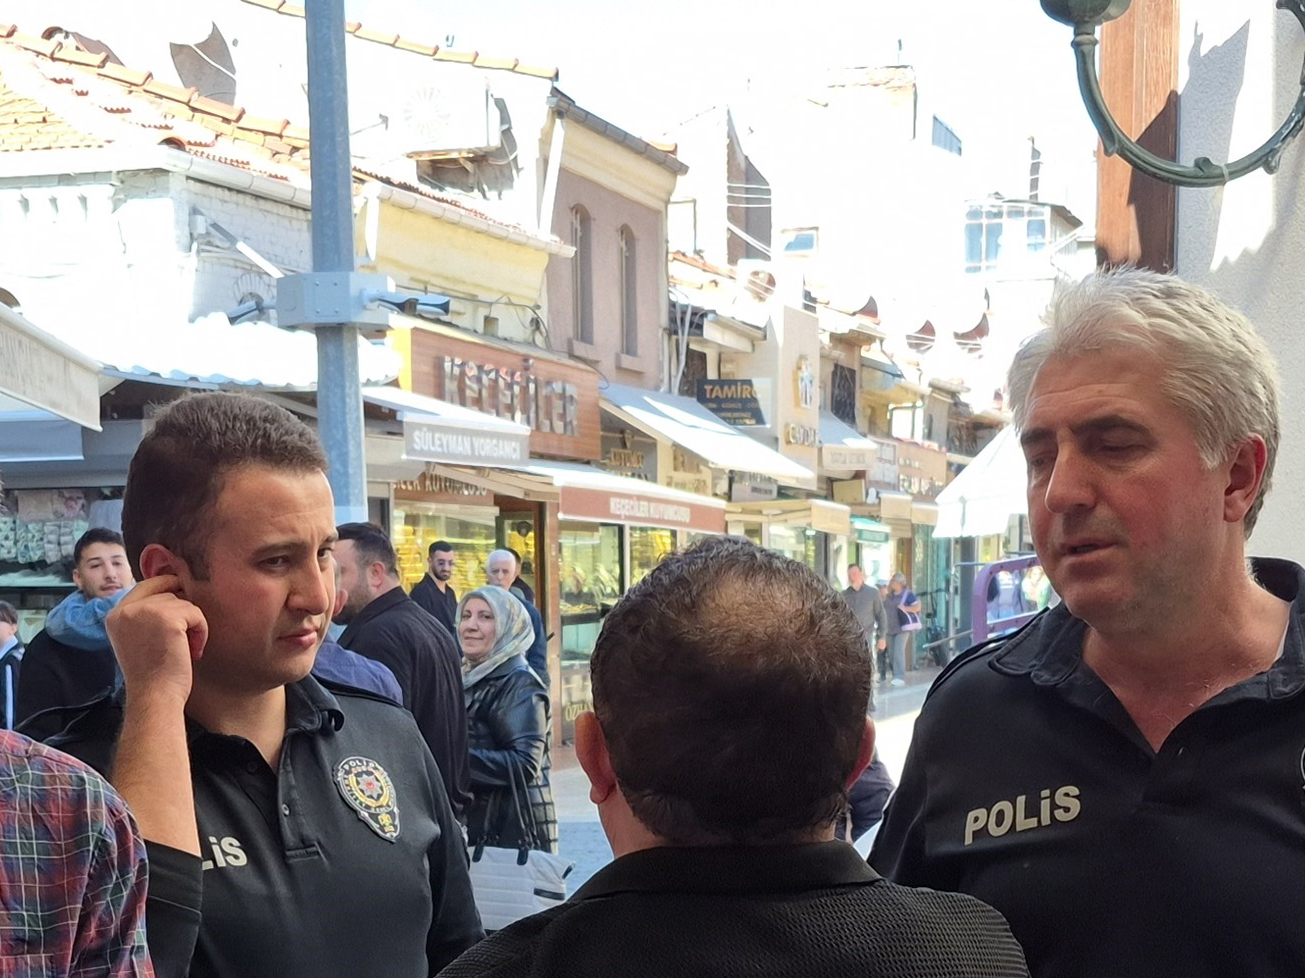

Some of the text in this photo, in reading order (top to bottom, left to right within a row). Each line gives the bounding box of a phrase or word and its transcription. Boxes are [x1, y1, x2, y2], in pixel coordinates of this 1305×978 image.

[704, 384, 763, 399] TAMİRC
[413, 427, 520, 460] SÜLEYMAN YORGANCI
